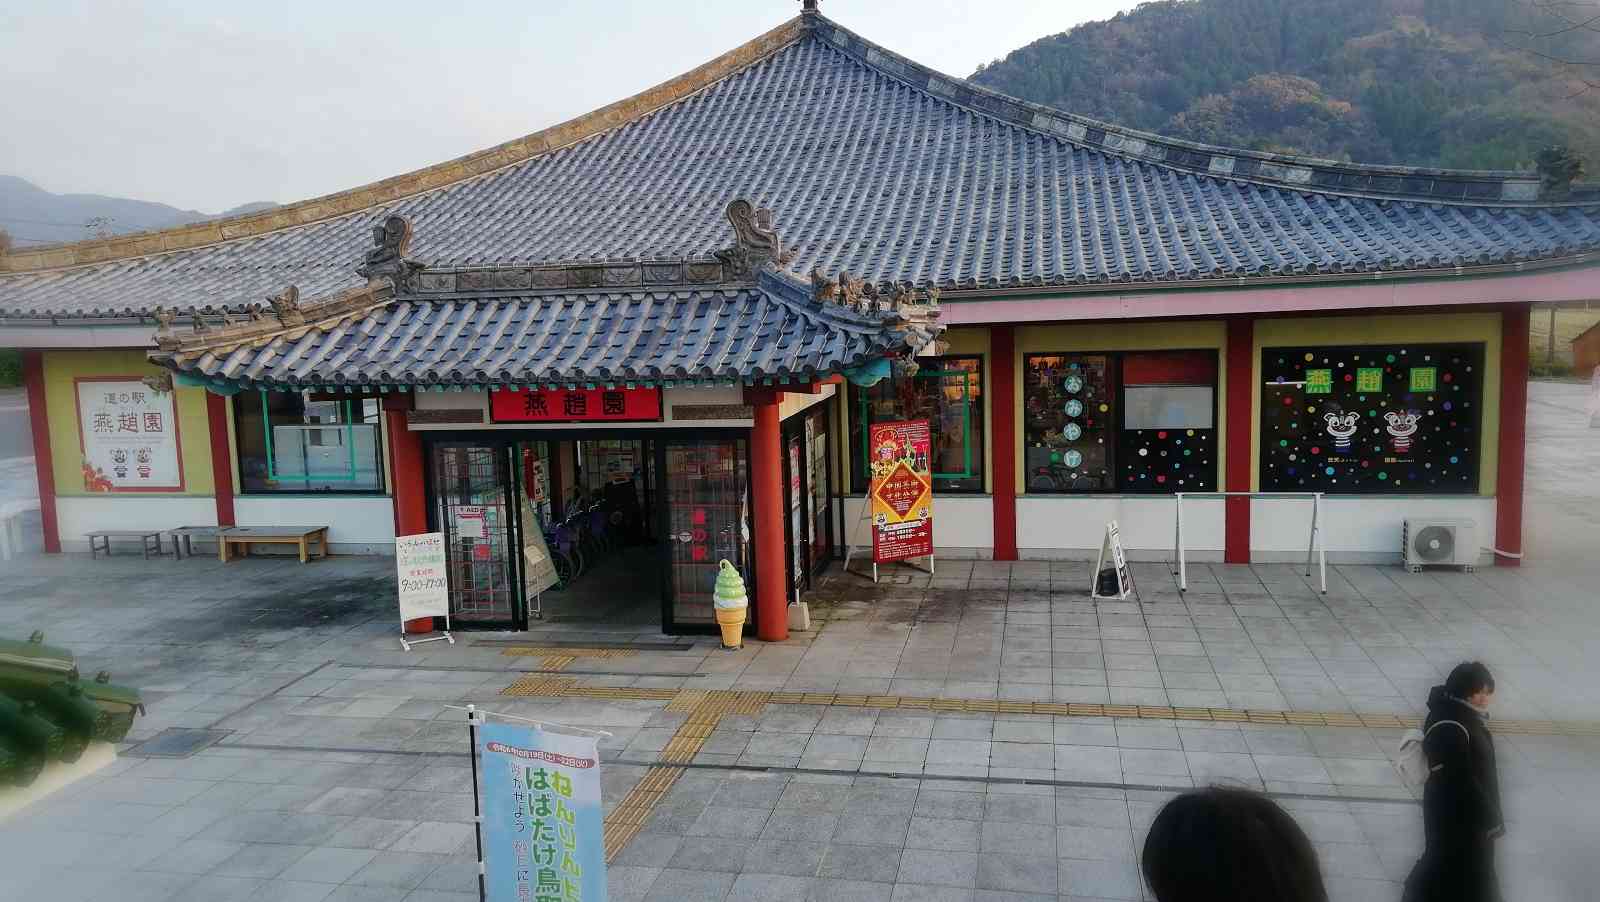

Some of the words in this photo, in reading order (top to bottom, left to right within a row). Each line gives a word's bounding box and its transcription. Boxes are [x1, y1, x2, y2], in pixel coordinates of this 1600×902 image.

[104, 392, 146, 404] 道の駅
[523, 390, 625, 417] 燕趙園
[94, 408, 163, 433] 燕趙園
